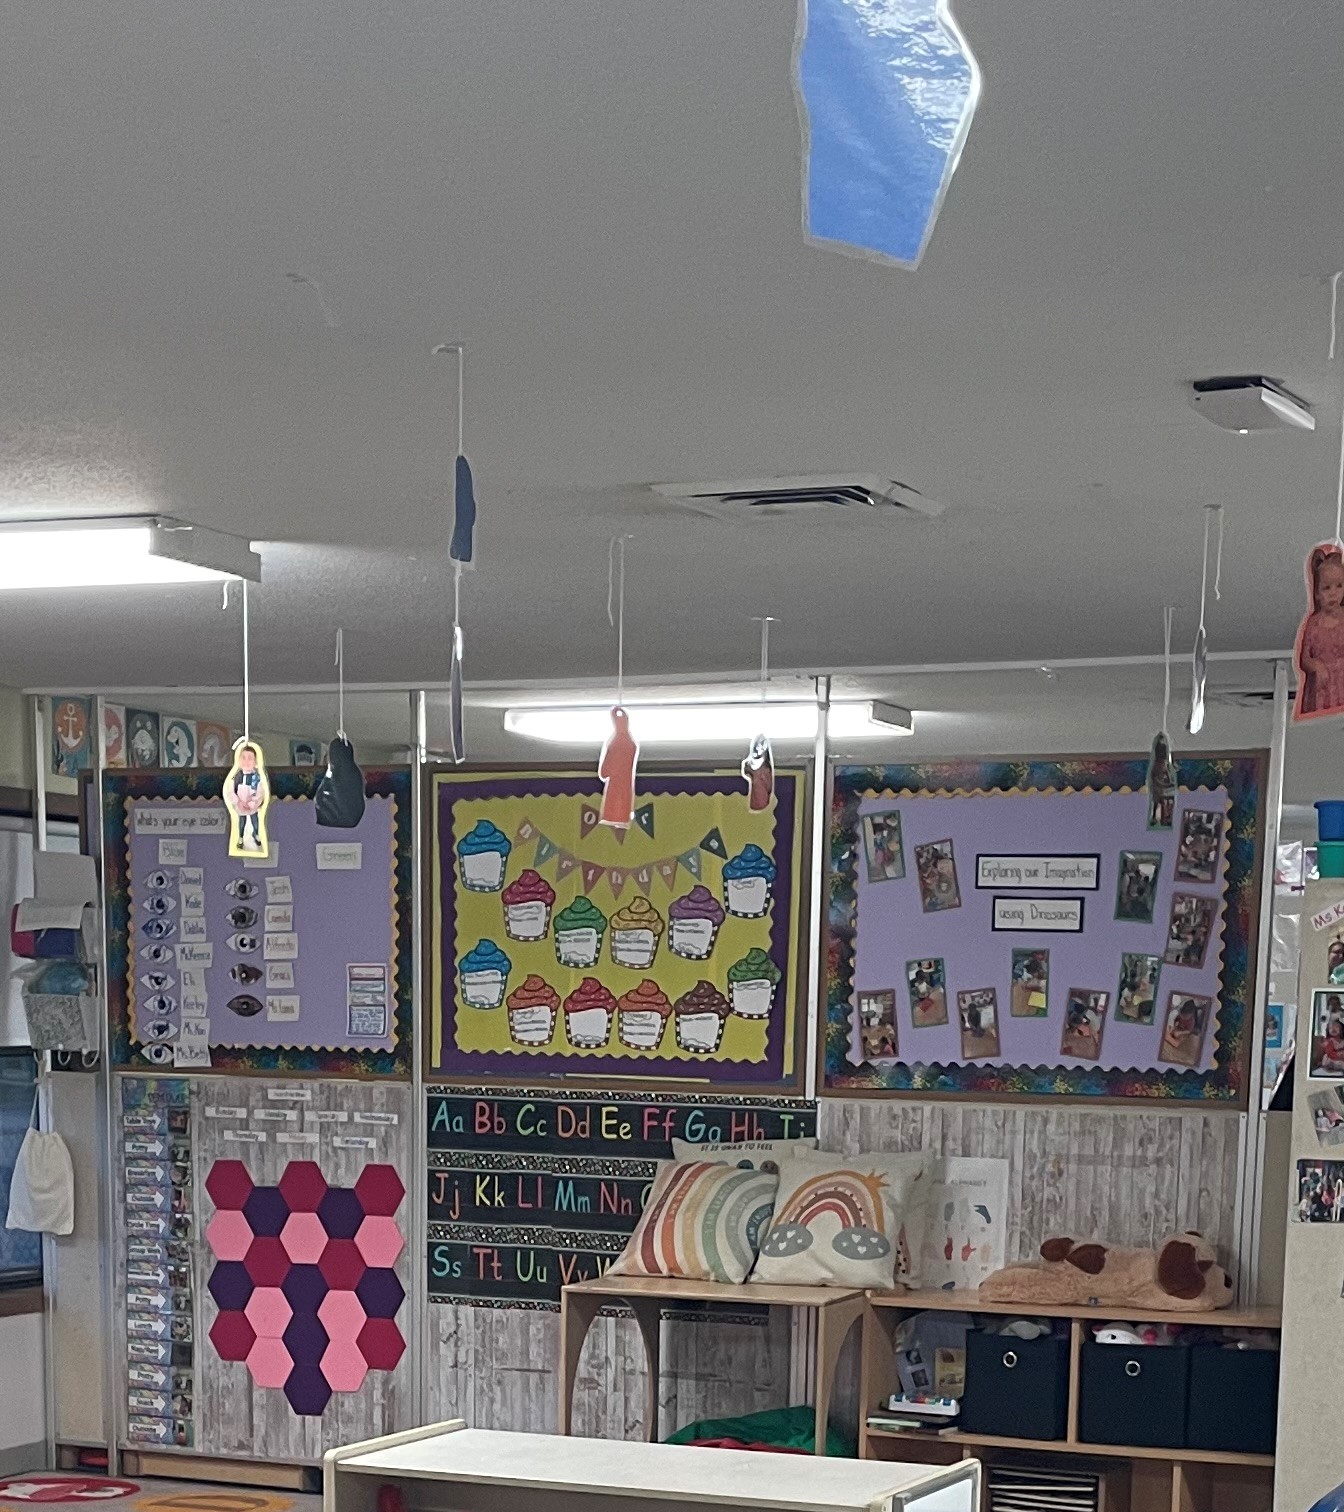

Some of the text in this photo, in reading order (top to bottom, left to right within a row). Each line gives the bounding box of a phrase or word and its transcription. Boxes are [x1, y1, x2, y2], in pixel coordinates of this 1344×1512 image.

[981, 861, 1021, 883] Exploring
[1025, 867, 1039, 878] our
[999, 903, 1078, 926] using Dinosaurs
[431, 1100, 464, 1133] Aa
[474, 1101, 506, 1134] Bb
[516, 1103, 548, 1137] Cc
[558, 1105, 591, 1138] Dd
[601, 1106, 632, 1140] Ee
[642, 1107, 677, 1142] Ff
[730, 1111, 765, 1143] Hh
[431, 1172, 632, 1220] Jj Kk Ll Mm Nn
[432, 1245, 462, 1278] Ss
[472, 1247, 503, 1281] Tt
[517, 1249, 548, 1284] Uu
